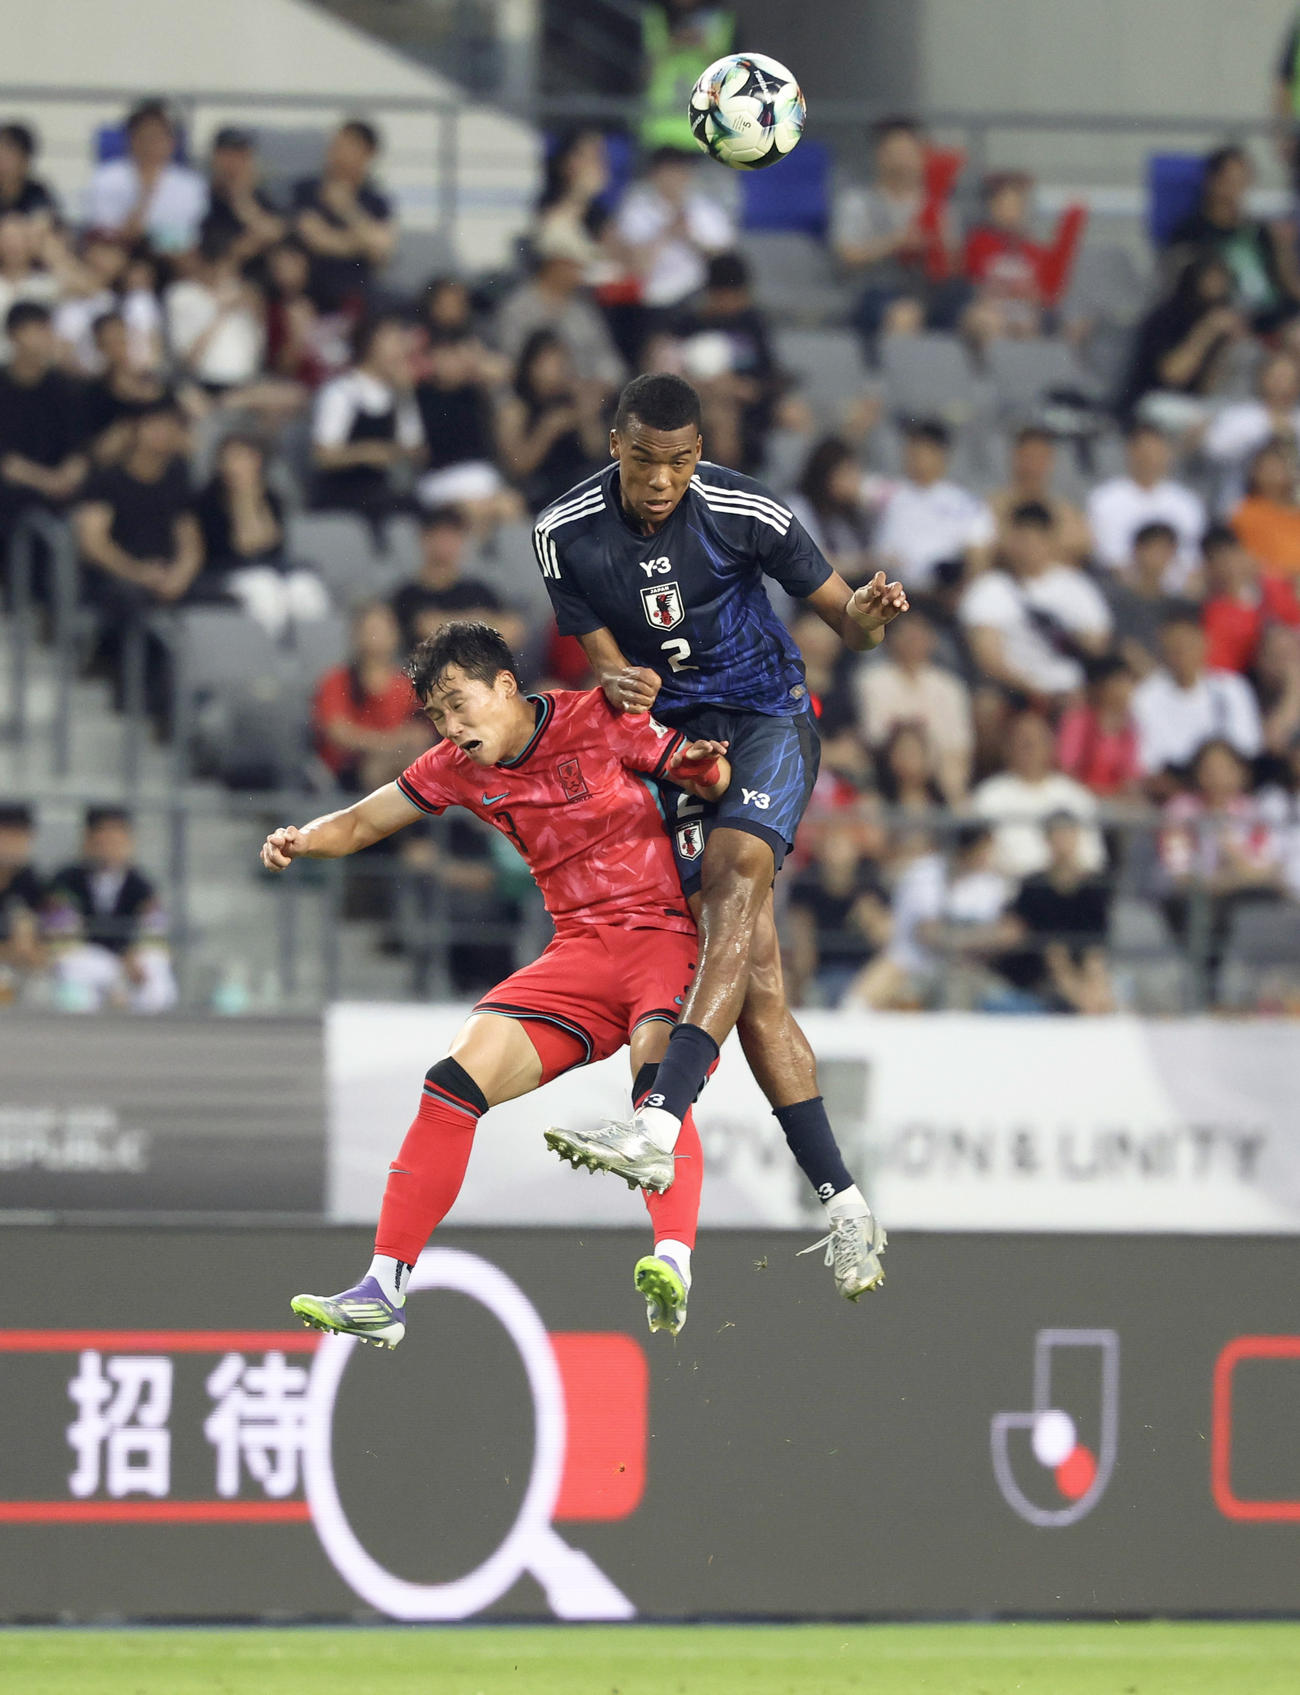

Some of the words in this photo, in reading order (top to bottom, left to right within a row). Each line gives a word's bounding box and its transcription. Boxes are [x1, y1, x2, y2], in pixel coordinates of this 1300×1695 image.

[650, 585, 670, 594] JAPAN
[660, 637, 700, 673] 2
[67, 1348, 308, 1498] 招待
